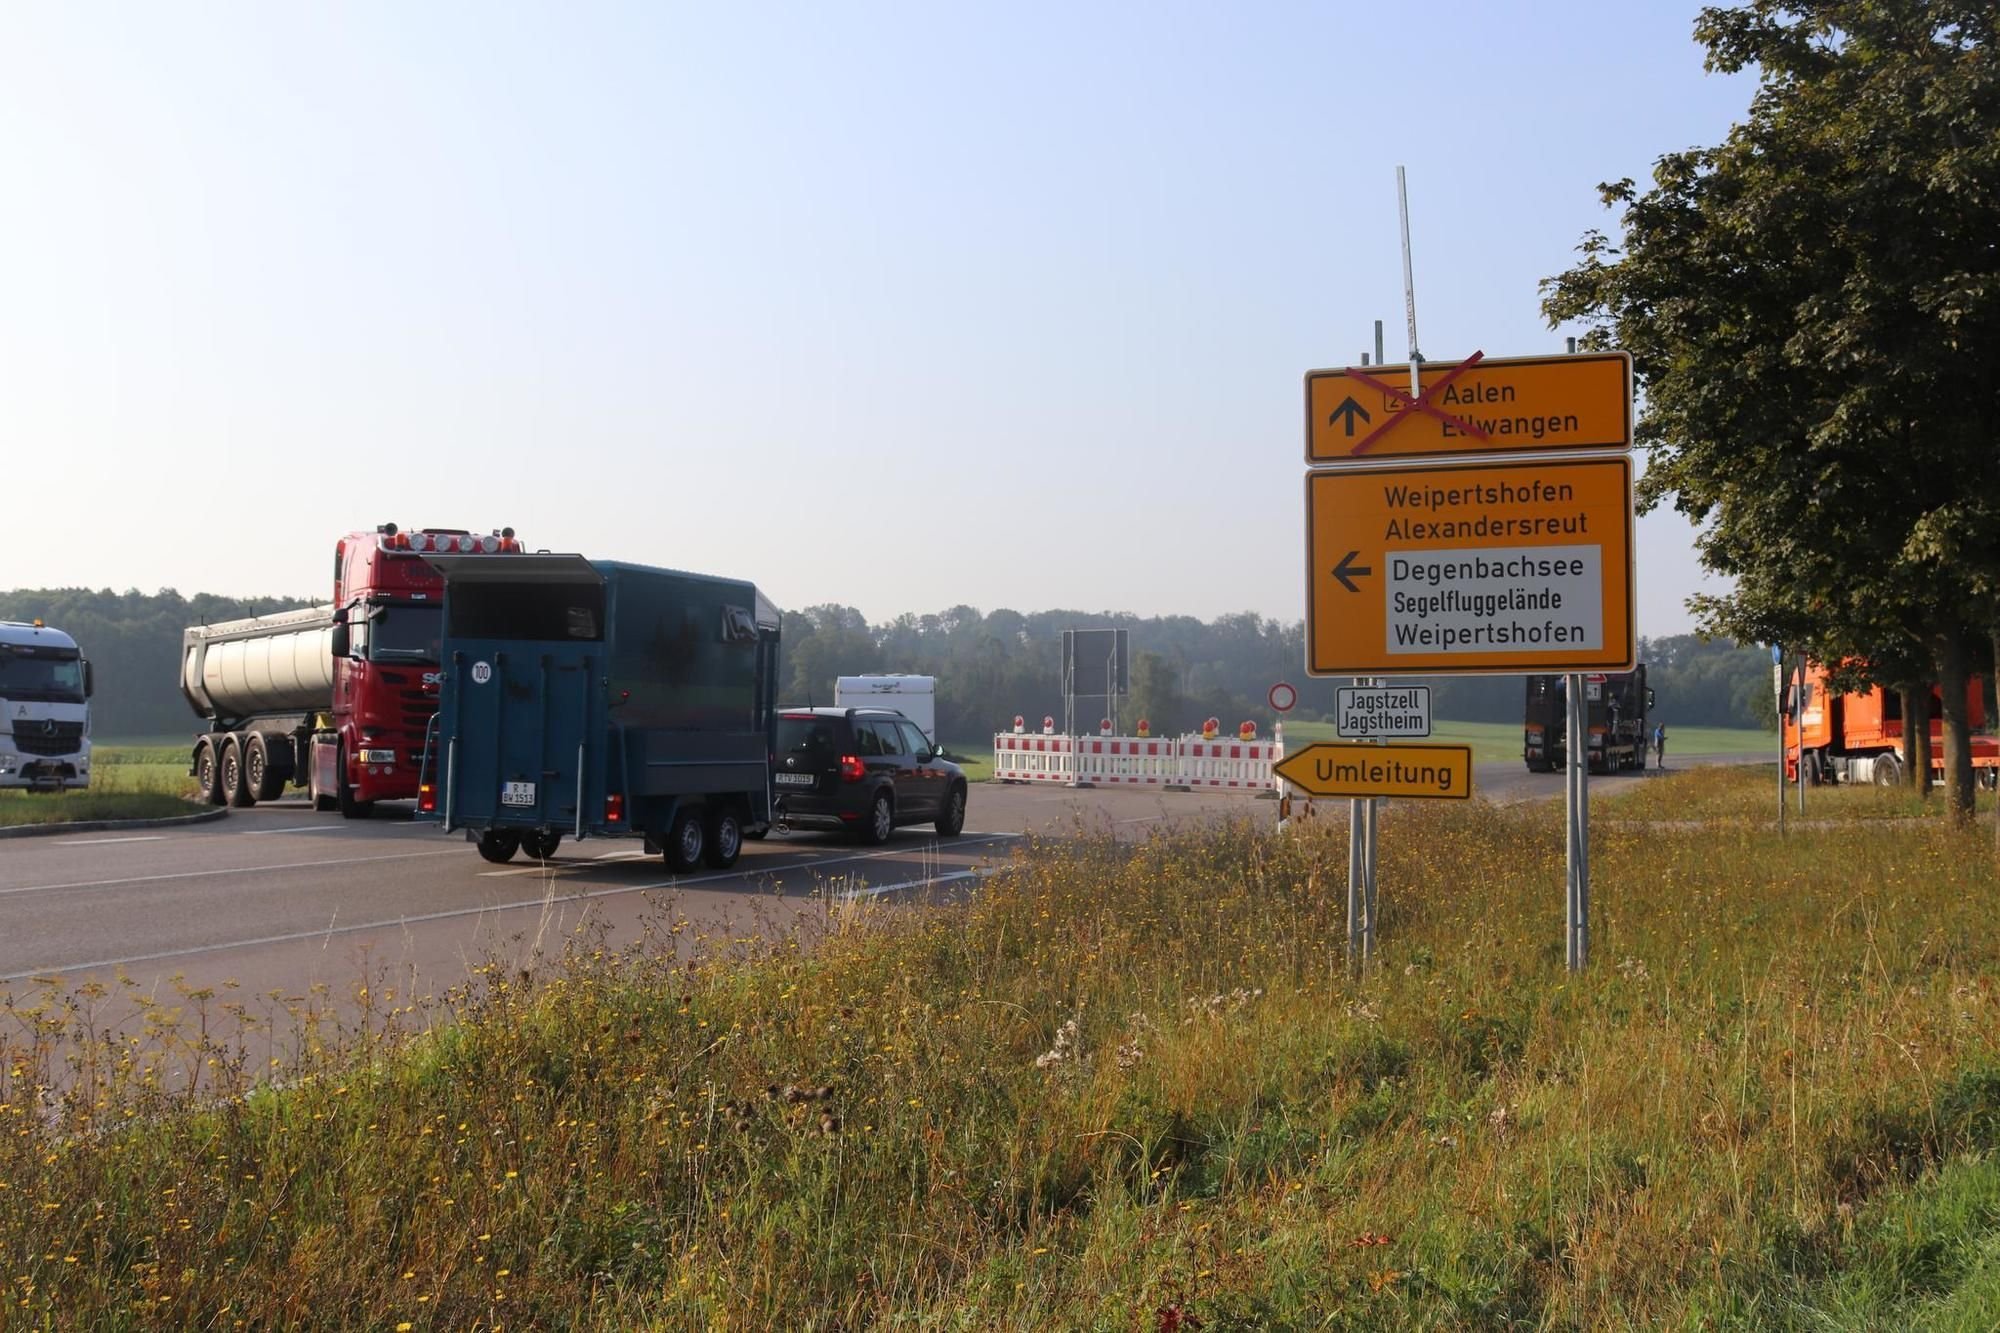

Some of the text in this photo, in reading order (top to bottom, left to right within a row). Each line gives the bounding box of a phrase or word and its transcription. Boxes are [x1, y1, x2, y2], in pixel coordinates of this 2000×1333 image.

[1442, 383, 1515, 406] Aalen
[1442, 412, 1579, 439] Ellwangen
[1384, 481, 1573, 512] Weipertshofen
[1385, 512, 1588, 541] Alexandersreut
[1393, 556, 1584, 586] Degenbachsee
[1394, 587, 1562, 619] Segelfluggelände
[1395, 621, 1585, 651] Weipertshofen
[475, 665, 489, 679] 100
[1347, 689, 1419, 714] Jagstzell
[1341, 710, 1423, 735] Jagstheim
[1316, 759, 1452, 791] Umleitung
